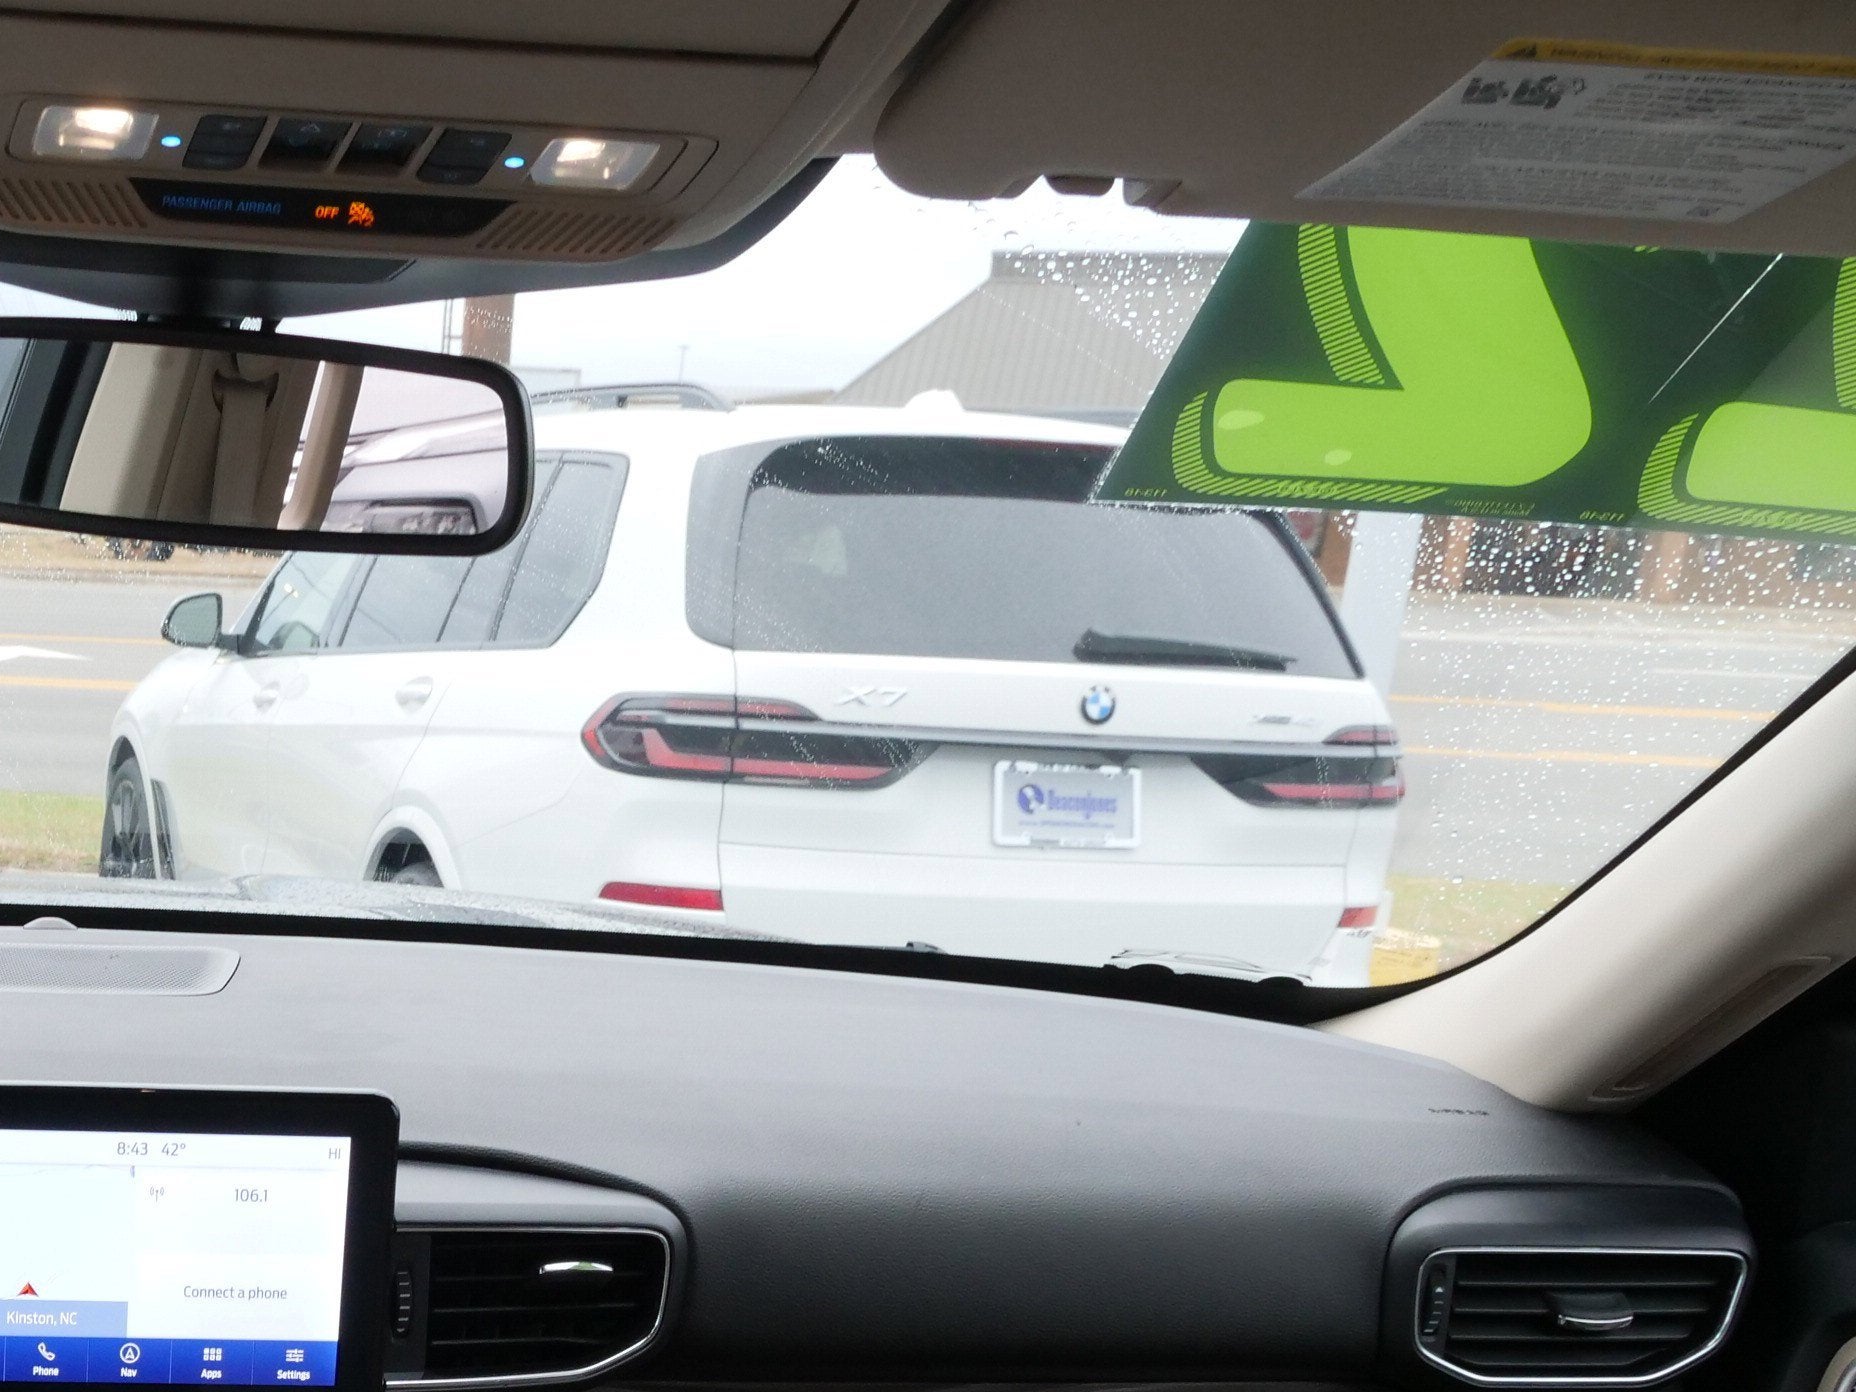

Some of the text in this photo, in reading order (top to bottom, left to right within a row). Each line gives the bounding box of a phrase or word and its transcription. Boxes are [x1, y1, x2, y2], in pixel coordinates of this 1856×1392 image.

[162, 194, 282, 215] PASSENGER AIRBAG
[315, 205, 340, 219] OFF
[834, 686, 909, 706] X7
[117, 1141, 186, 1157] 8:43 42°
[328, 1148, 341, 1160] HI
[234, 1188, 268, 1203] 106.1
[183, 1285, 287, 1300] Connect a phone
[6, 1311, 77, 1326] Kinston, NC
[33, 1365, 59, 1376] Phone
[120, 1367, 137, 1377] Nav
[200, 1368, 222, 1380] Apps
[276, 1369, 310, 1381] Settings
